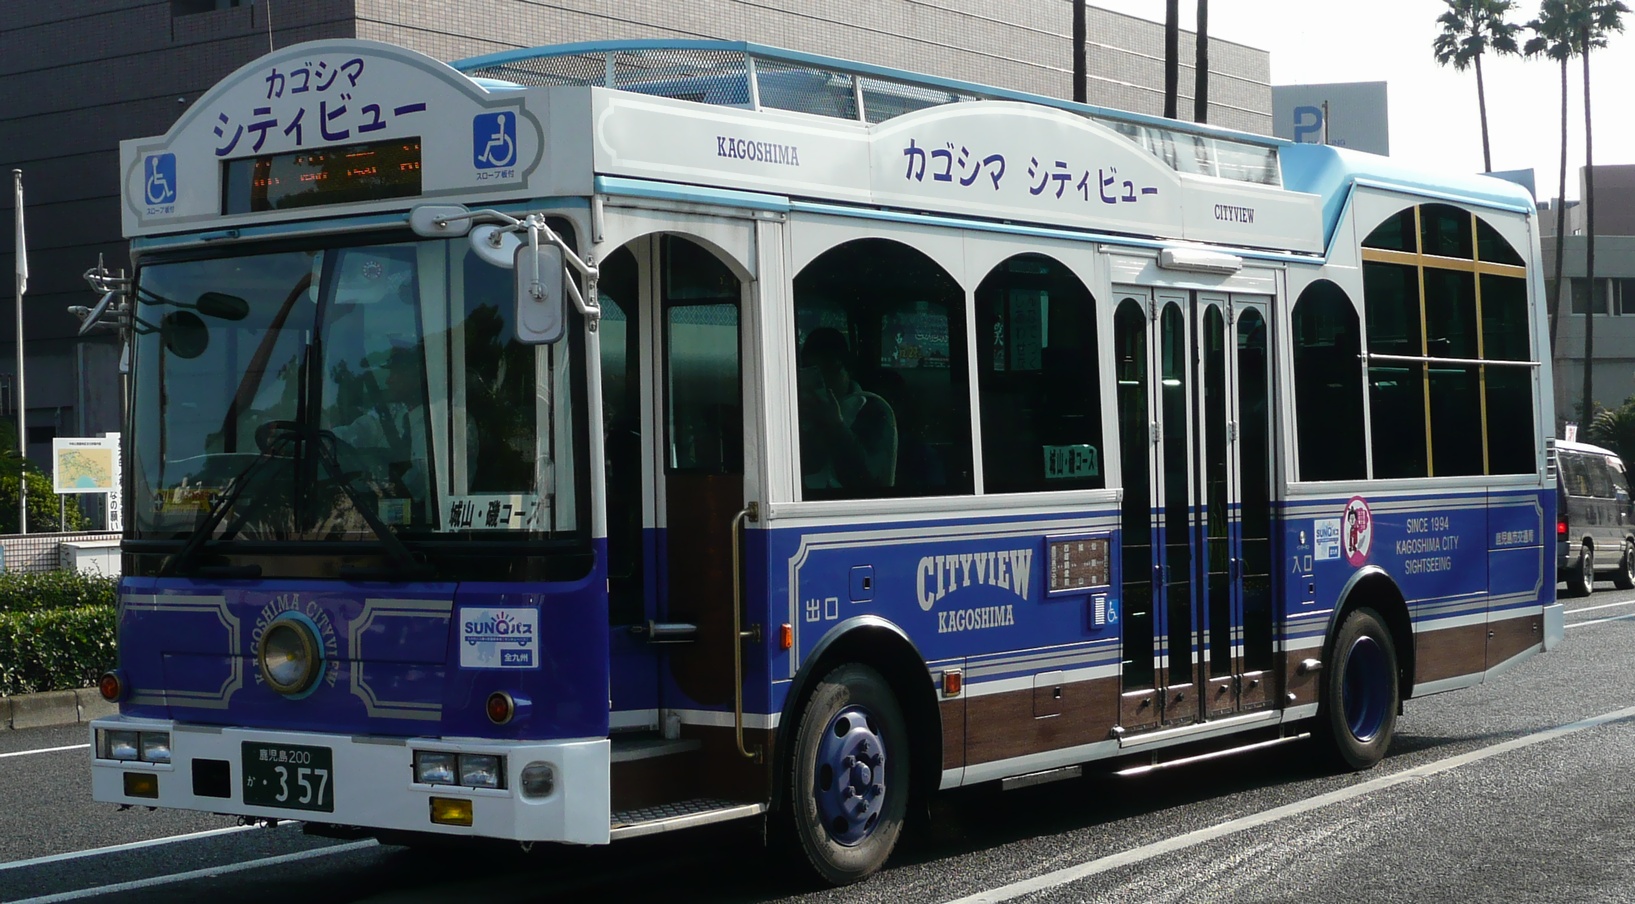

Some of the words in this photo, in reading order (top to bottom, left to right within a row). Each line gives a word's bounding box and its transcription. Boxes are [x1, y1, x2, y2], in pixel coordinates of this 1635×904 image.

[265, 58, 365, 99] カゴシマ
[212, 93, 427, 157] シティビュー
[717, 136, 800, 167] KAGOSHIMA
[903, 138, 1006, 191] カゴシマ
[1028, 156, 1158, 204] シティビュー
[1213, 204, 1255, 224] CITYVIEW
[1406, 518, 1428, 533] SINCE
[1431, 516, 1449, 532] 1994
[1396, 537, 1440, 555] KAGOSHIMA
[1442, 535, 1459, 552] CITY
[1292, 555, 1312, 573] 入口
[1405, 556, 1451, 575] SIGHTSEEING
[917, 549, 1032, 611] CITYVIEW
[806, 597, 838, 622] 出口
[938, 605, 1014, 633] KAGOSHIMA
[306, 600, 340, 688] CITYVIEW
[504, 653, 529, 663] 全九州
